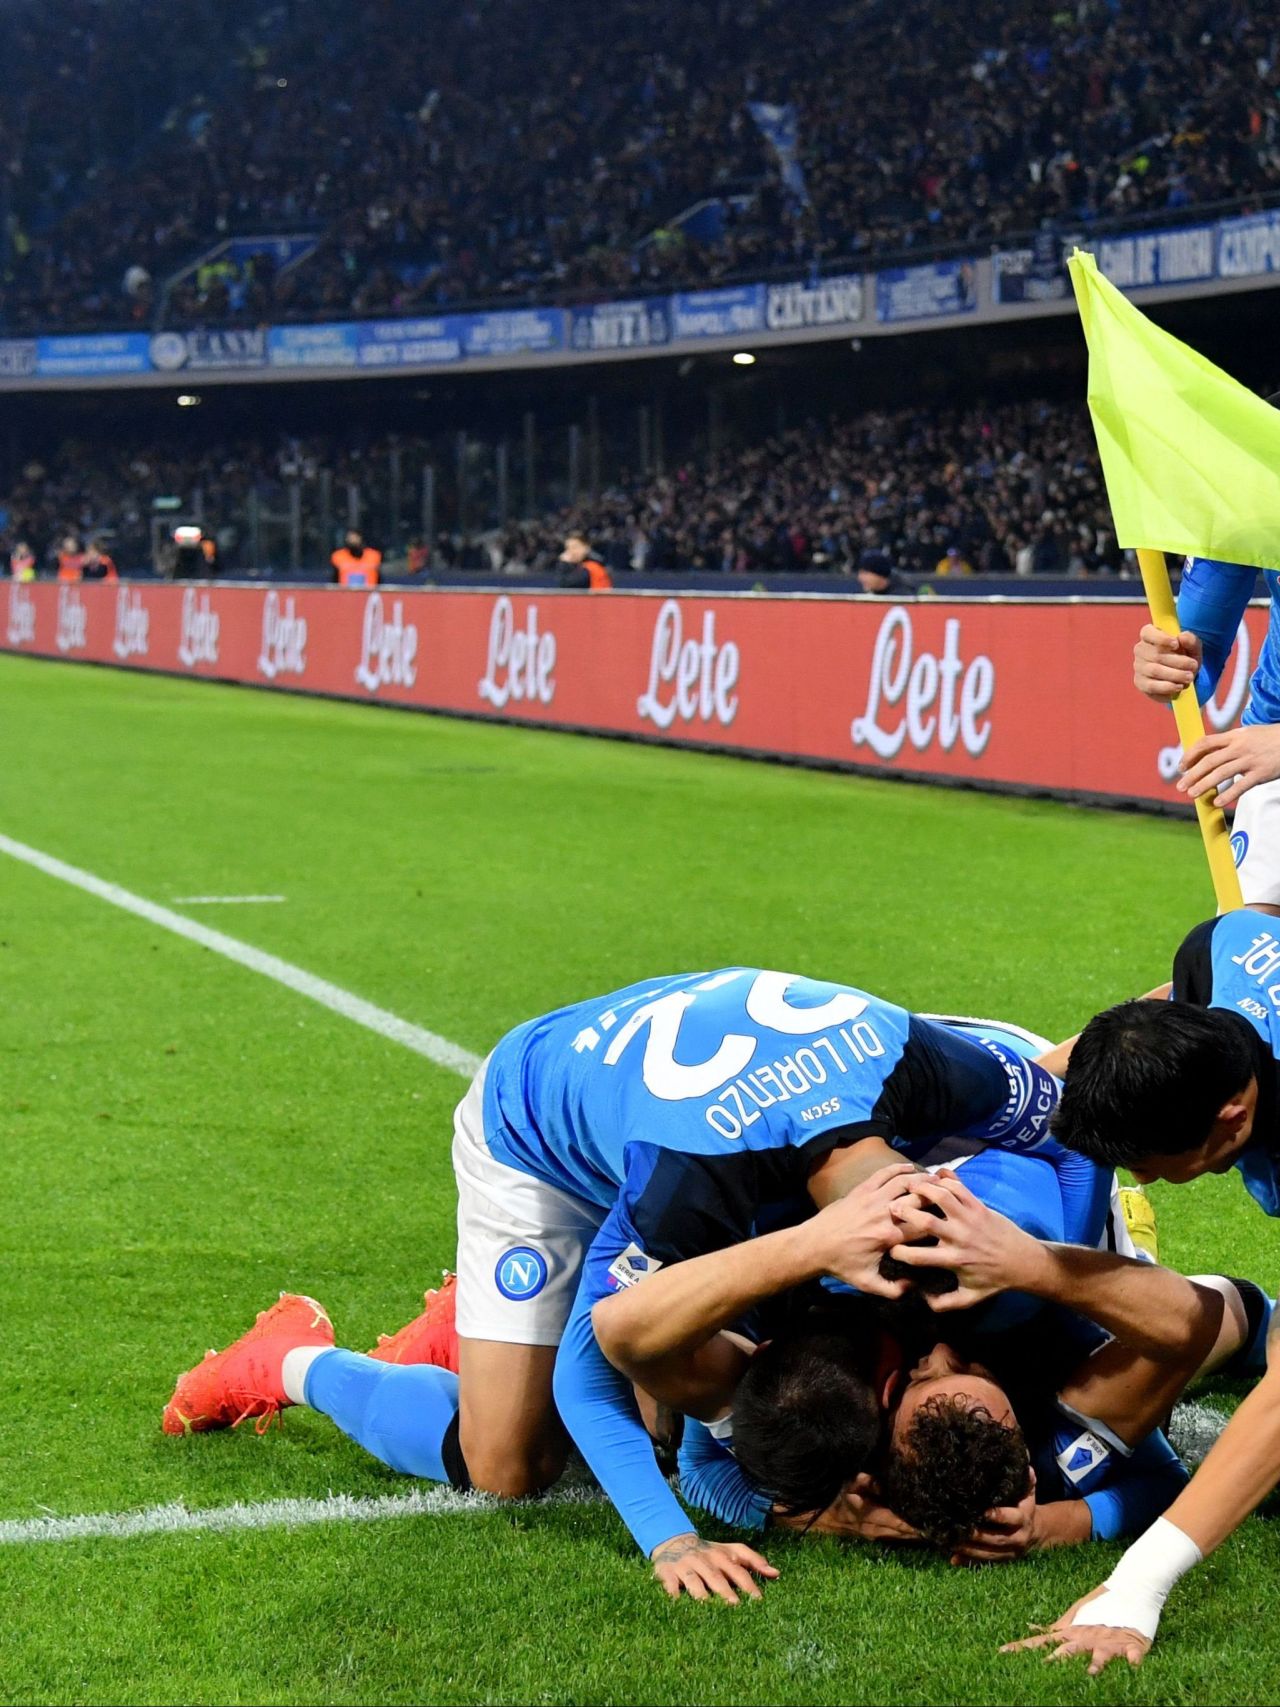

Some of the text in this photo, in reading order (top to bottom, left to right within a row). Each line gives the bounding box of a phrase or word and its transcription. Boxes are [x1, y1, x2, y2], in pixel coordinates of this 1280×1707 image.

[113, 586, 150, 659] Lete
[178, 587, 220, 667] Lete
[258, 590, 308, 679] Lete
[355, 592, 419, 692] Lete
[479, 596, 557, 708] Lete
[636, 598, 741, 729] Lete
[850, 605, 996, 760] Lete
[704, 1020, 886, 1141] DI LORENZO
[799, 1096, 841, 1122] SSCN
[1001, 1077, 1052, 1148] PEACE
[508, 1260, 533, 1286] N
[616, 1263, 636, 1280] SERIE
